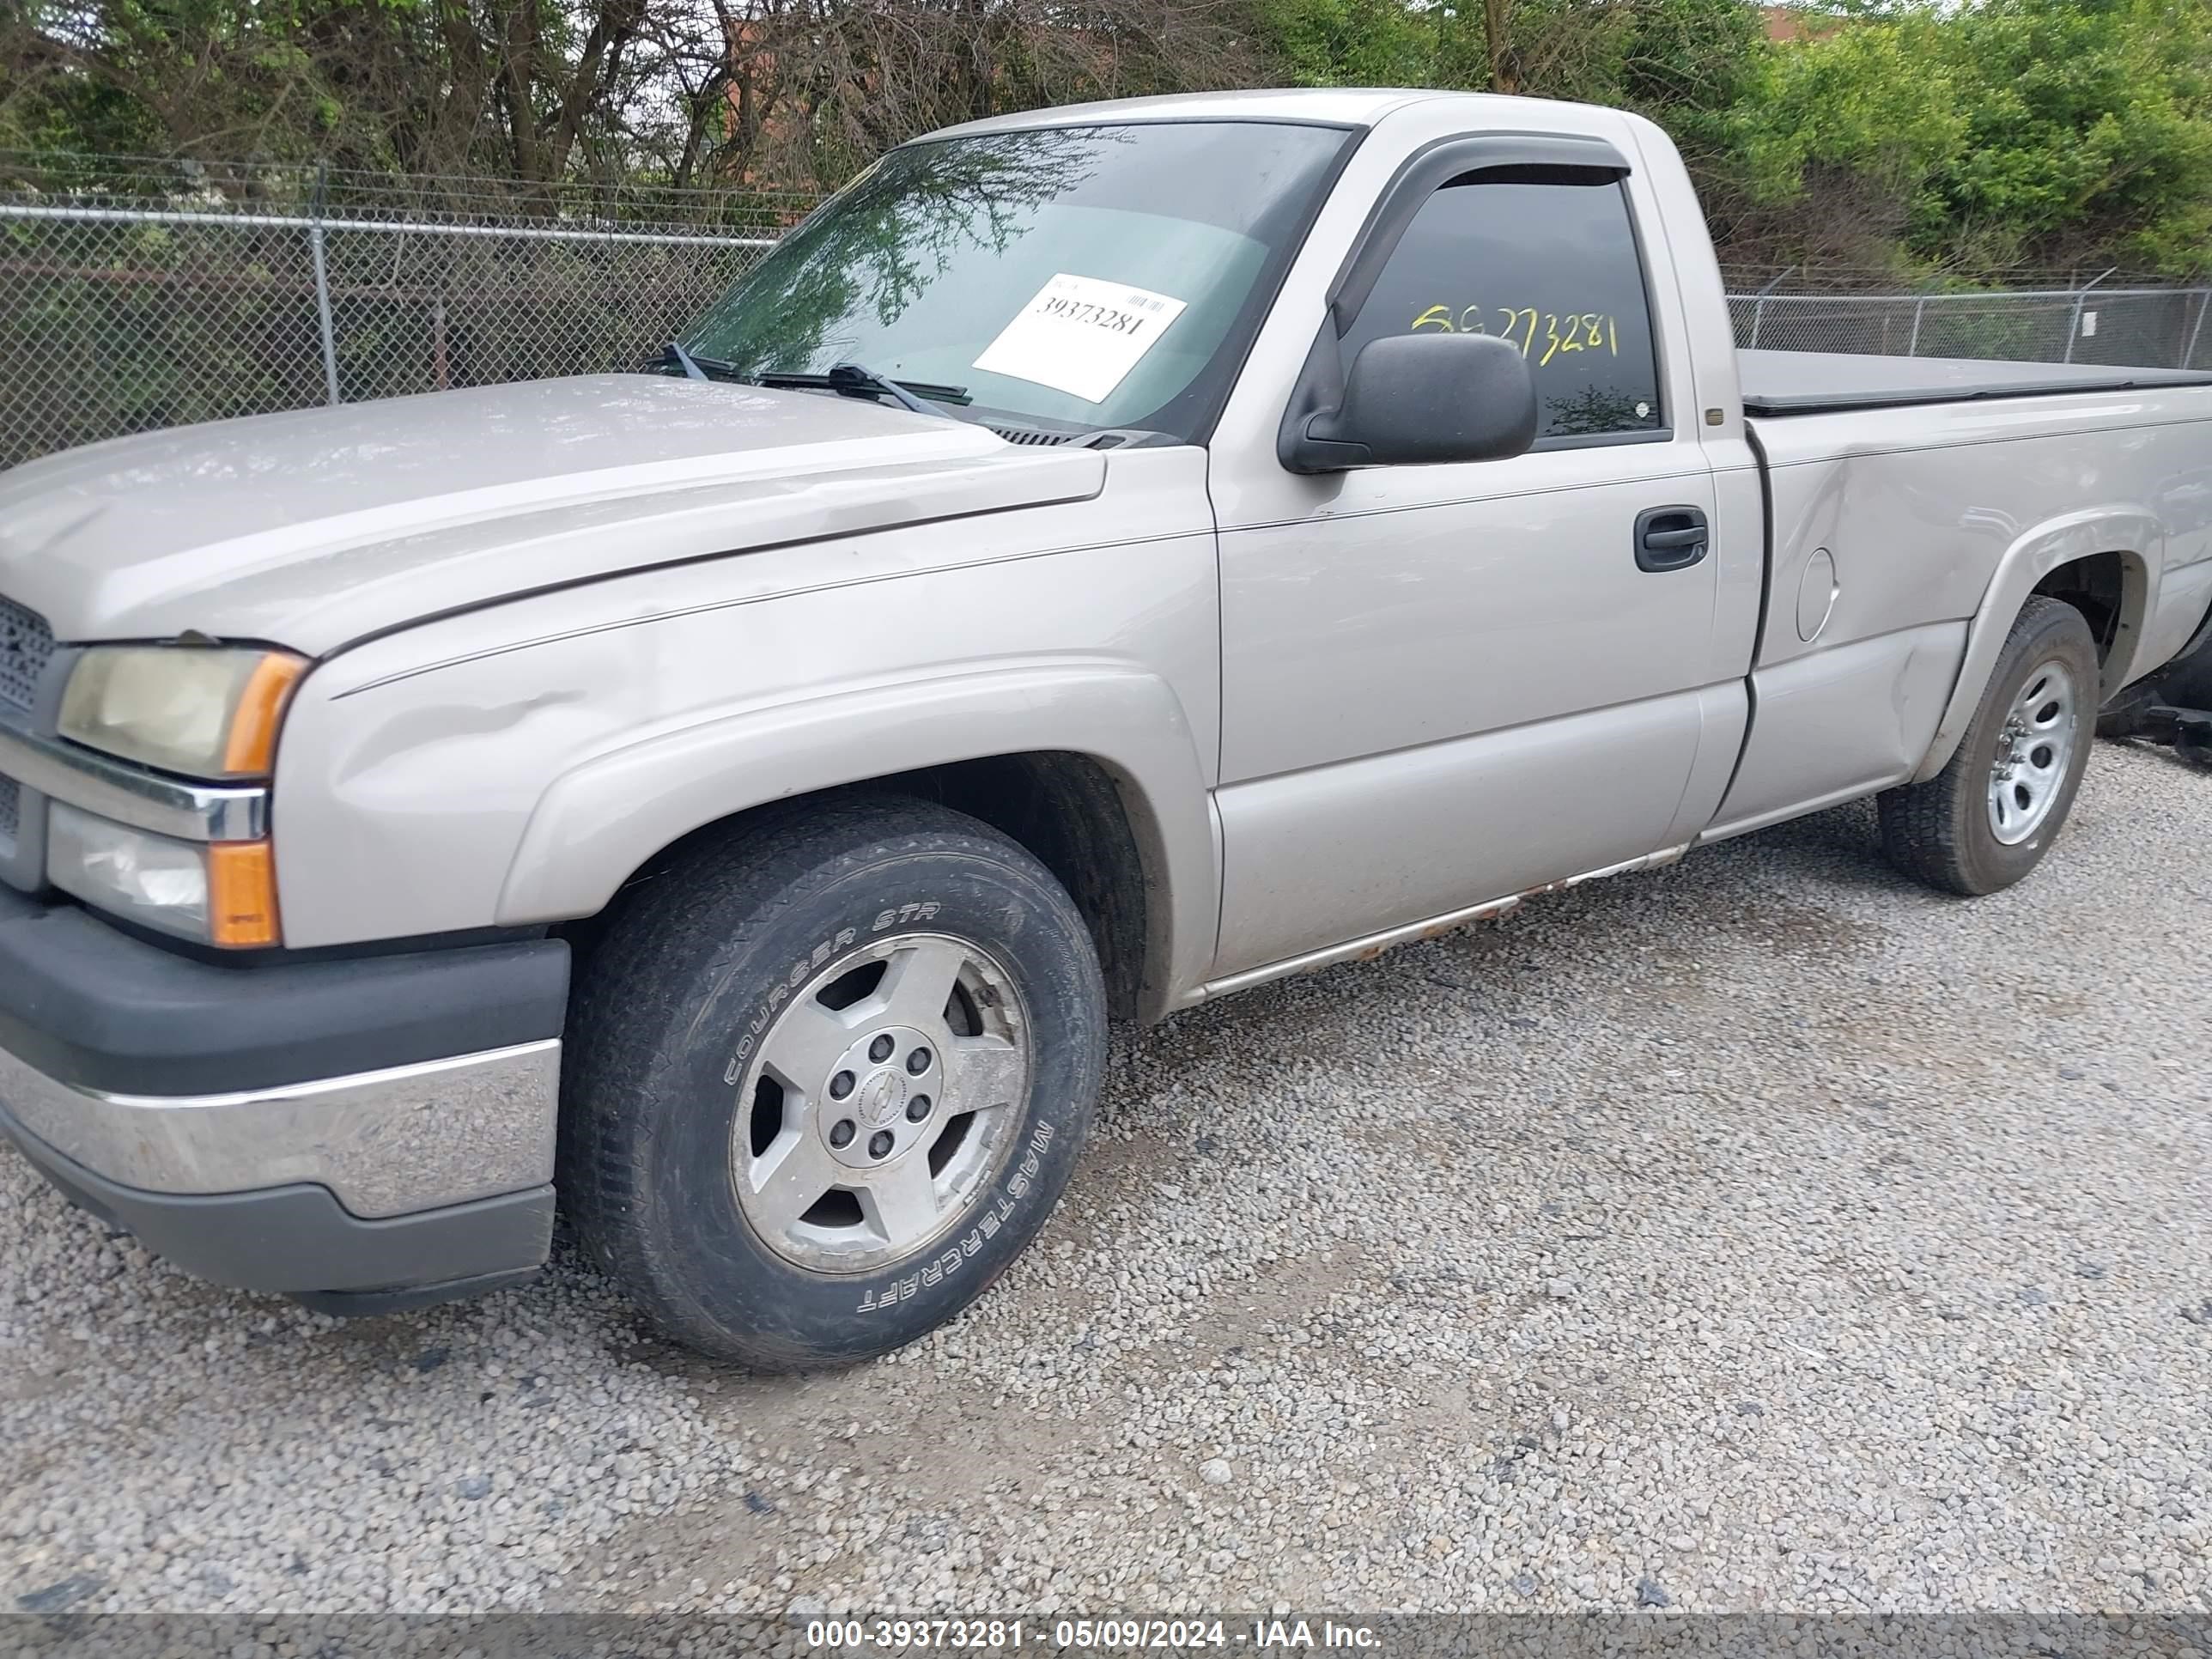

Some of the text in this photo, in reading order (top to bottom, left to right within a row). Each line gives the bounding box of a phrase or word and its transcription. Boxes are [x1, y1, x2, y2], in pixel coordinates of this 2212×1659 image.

[1036, 296, 1145, 335] 39373281
[724, 901, 941, 1086] COURSER STR
[856, 1120, 1055, 1314] MASTERCRAFT
